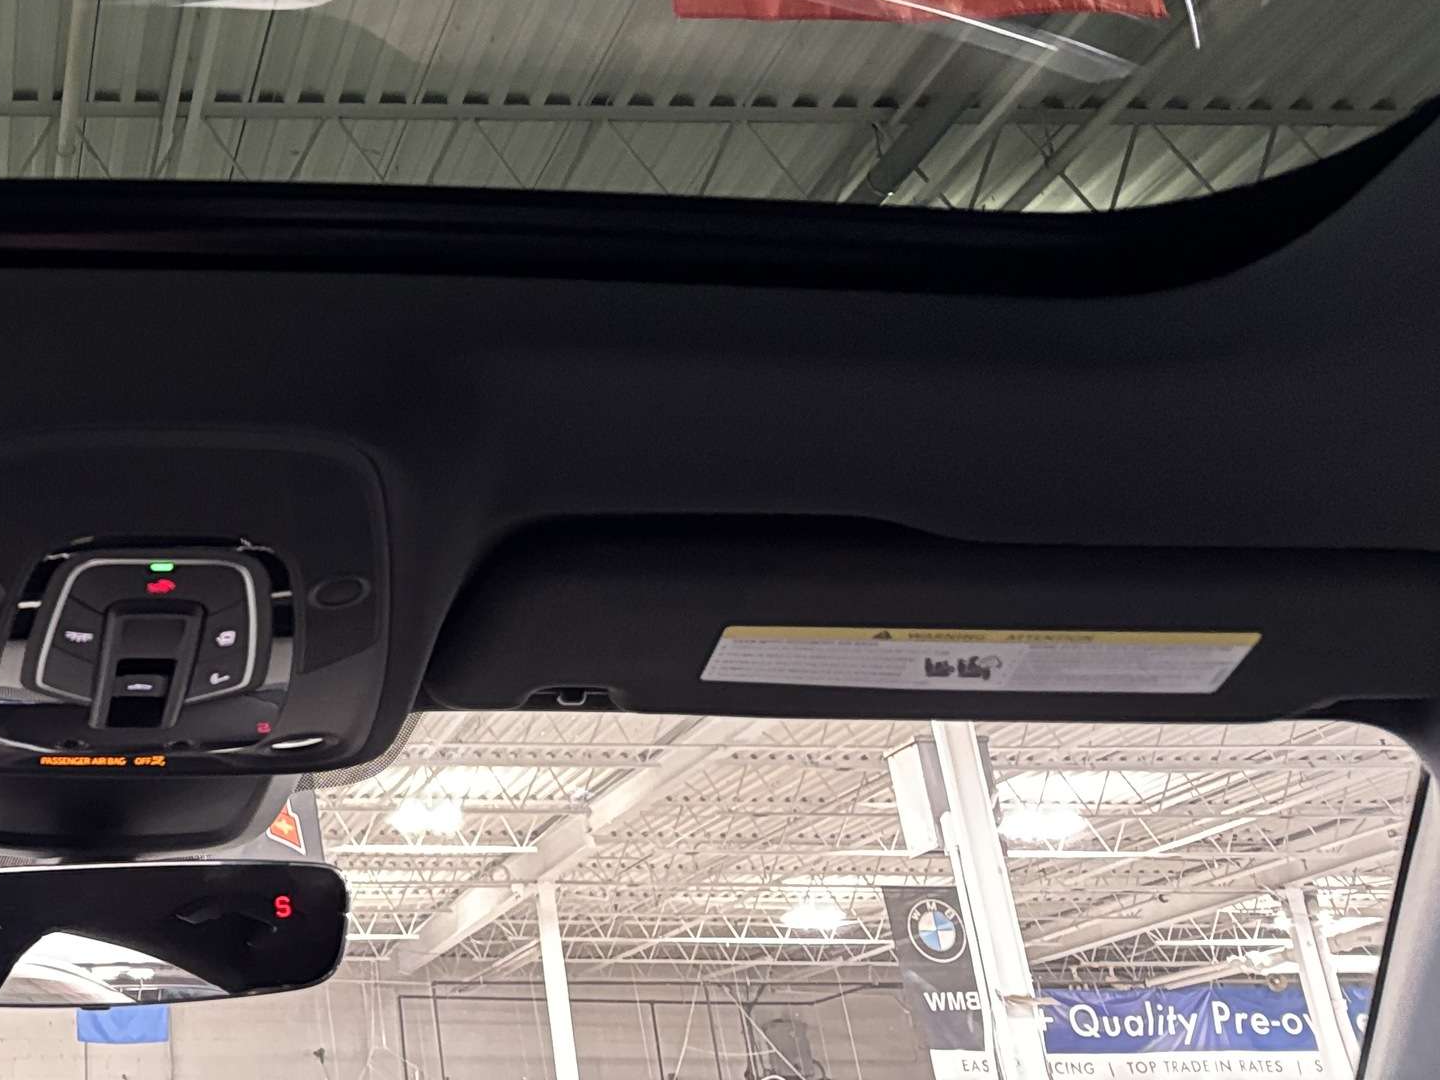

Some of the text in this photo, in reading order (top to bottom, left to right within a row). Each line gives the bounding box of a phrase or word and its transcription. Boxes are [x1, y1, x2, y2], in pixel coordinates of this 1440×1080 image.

[40, 756, 152, 766] PASSENGER AIR BAG OFF
[274, 895, 292, 918] S
[1068, 1001, 1198, 1046] Quality
[961, 1059, 990, 1073] EAS
[1126, 1061, 1157, 1075] TOP
[1163, 1060, 1211, 1073] TRADE
[1215, 1060, 1233, 1072] IN
[1239, 1060, 1283, 1073] RATES
